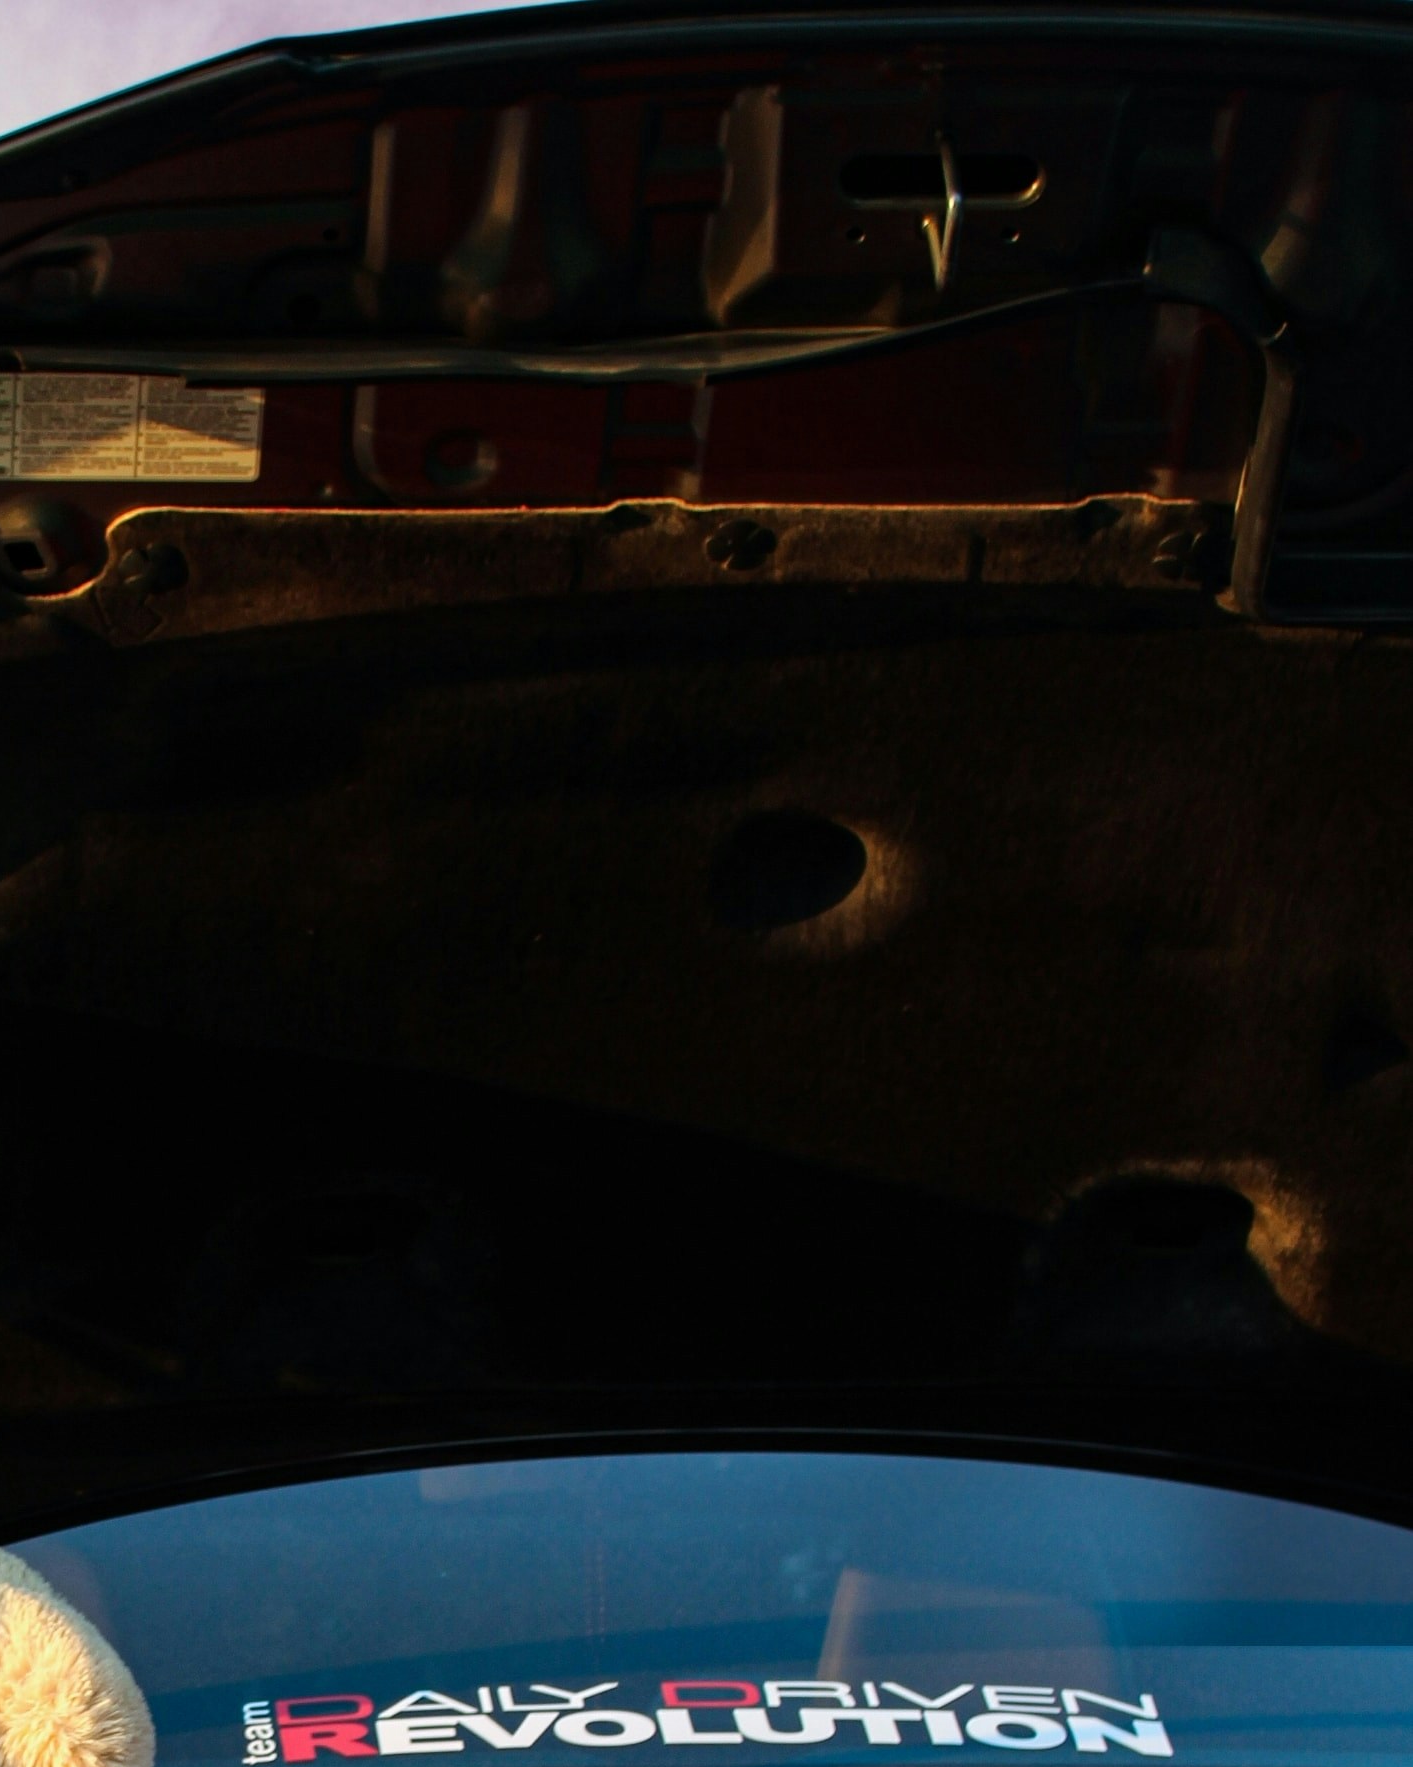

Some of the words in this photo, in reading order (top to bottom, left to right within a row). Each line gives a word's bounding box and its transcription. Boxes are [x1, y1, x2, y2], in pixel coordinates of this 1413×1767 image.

[275, 1681, 619, 1726] DAILY
[660, 1680, 1158, 1720] DRIVEN
[242, 1700, 277, 1766] team
[279, 1708, 1174, 1763] REVOLUTION
